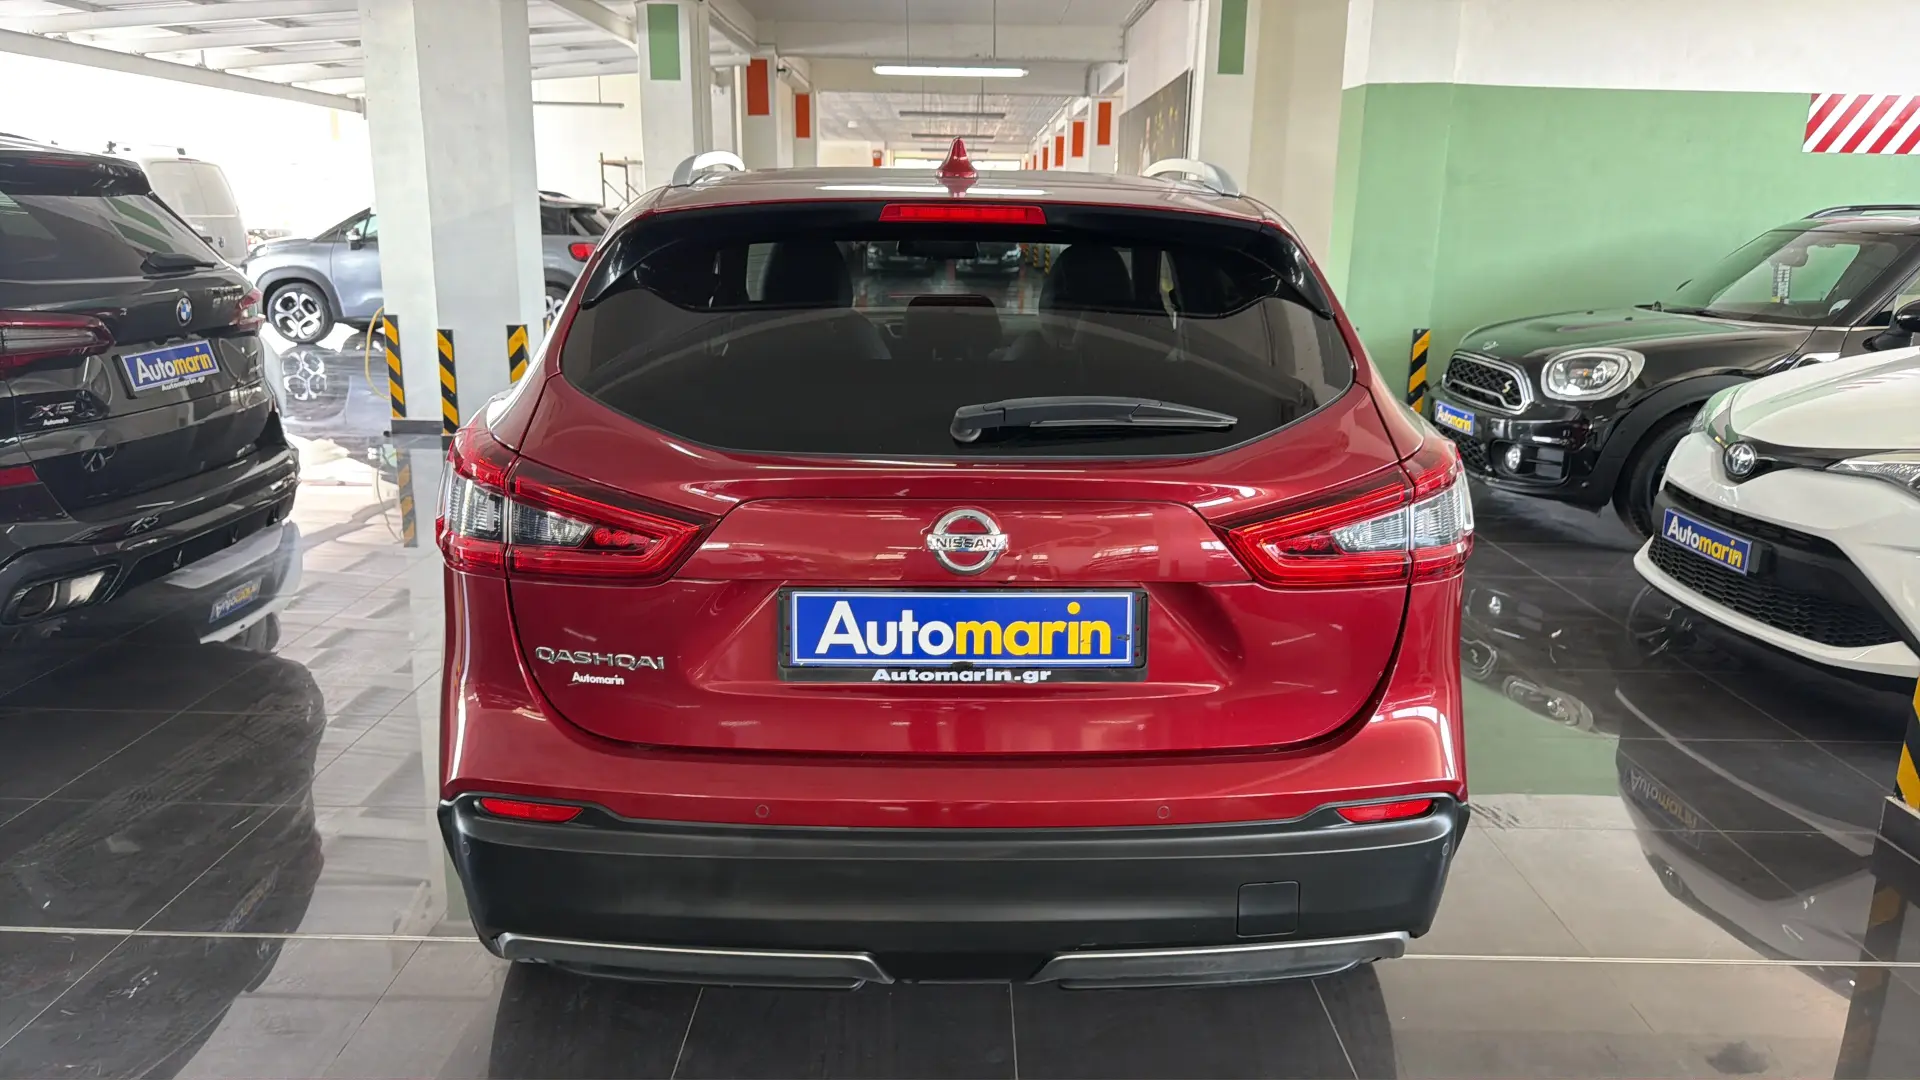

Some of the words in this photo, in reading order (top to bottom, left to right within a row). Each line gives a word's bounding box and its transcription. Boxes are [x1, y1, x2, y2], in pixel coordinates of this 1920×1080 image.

[135, 347, 213, 384] Automarin
[936, 538, 996, 549] NISSAN
[1667, 515, 1743, 568] Automarin
[814, 600, 1112, 656] Automarin
[535, 646, 665, 671] QASHQAI
[572, 671, 625, 685] Automarin
[871, 668, 1052, 684] Automarin.gr
